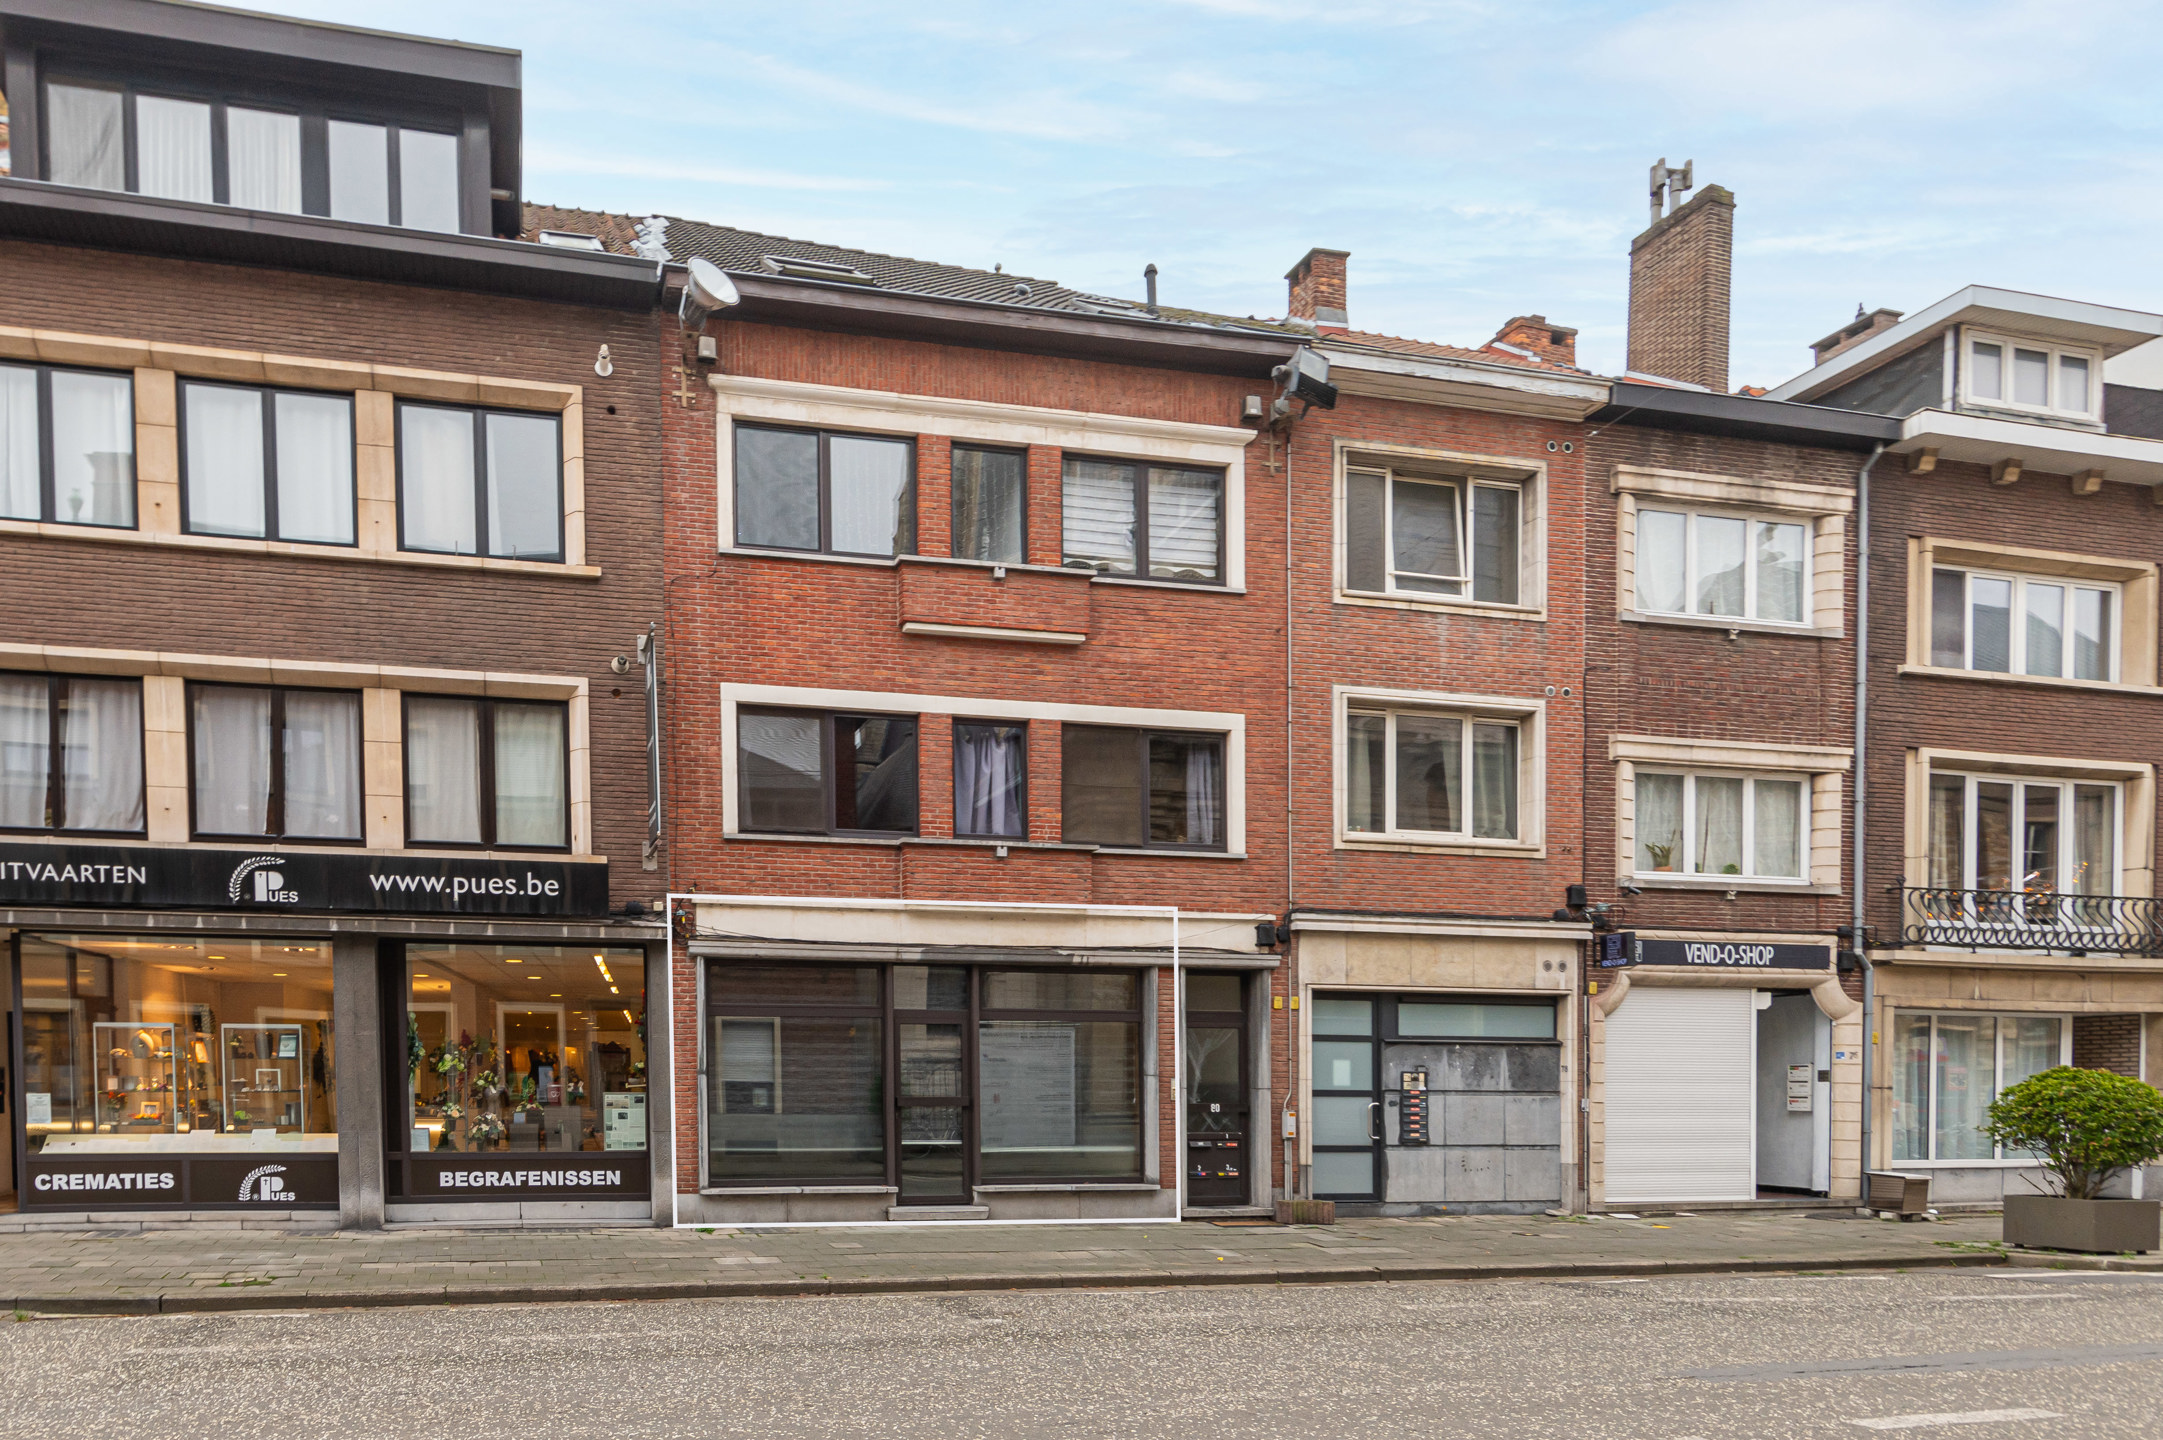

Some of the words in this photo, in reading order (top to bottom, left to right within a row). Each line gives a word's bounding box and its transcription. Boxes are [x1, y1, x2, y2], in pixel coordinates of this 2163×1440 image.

[0, 861, 147, 885] ITVAARTEN
[369, 872, 560, 901] www.pues.be
[1684, 943, 1775, 966] VEND-O-SHOP
[34, 1172, 175, 1191] CREMATIES
[439, 1170, 621, 1187] BEGRAFENISSEN
